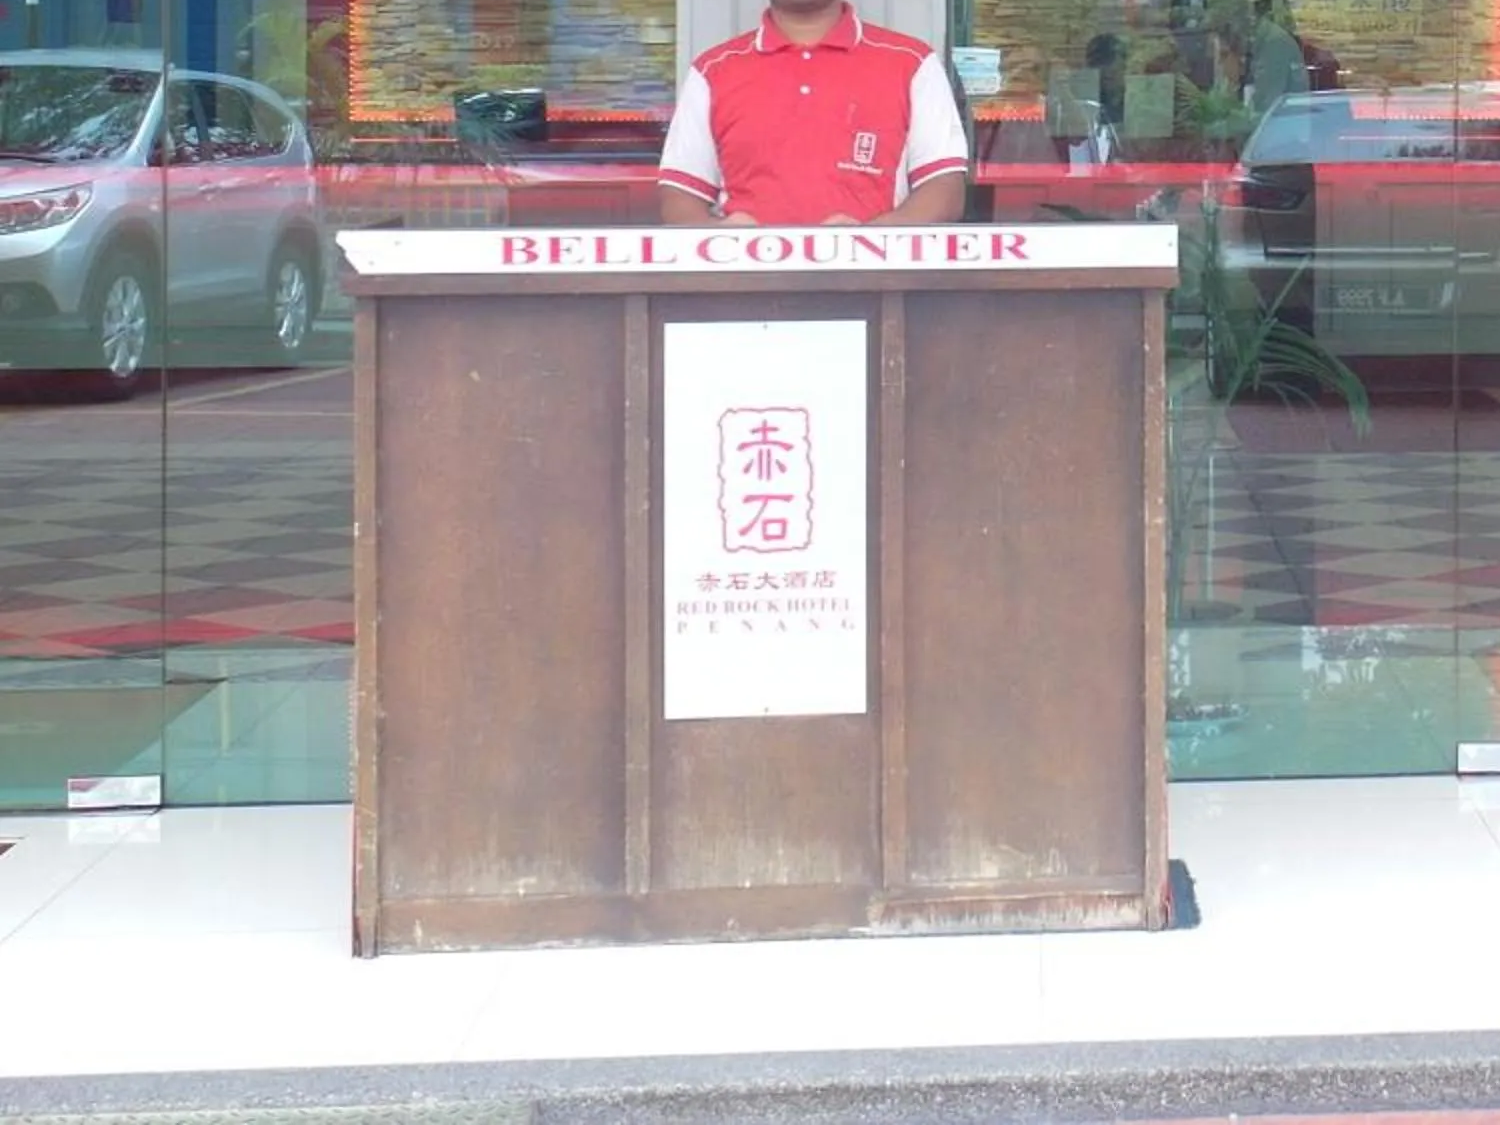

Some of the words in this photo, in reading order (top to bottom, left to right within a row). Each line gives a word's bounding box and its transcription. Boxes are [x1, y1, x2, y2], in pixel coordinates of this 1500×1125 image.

[501, 235, 677, 266] BELL
[696, 232, 1031, 264] COUNTER
[736, 418, 795, 542] 赤石
[695, 570, 838, 593] 赤石大酒店
[676, 600, 718, 616] RED
[722, 599, 780, 615] ROCK
[786, 596, 852, 613] HOTEL
